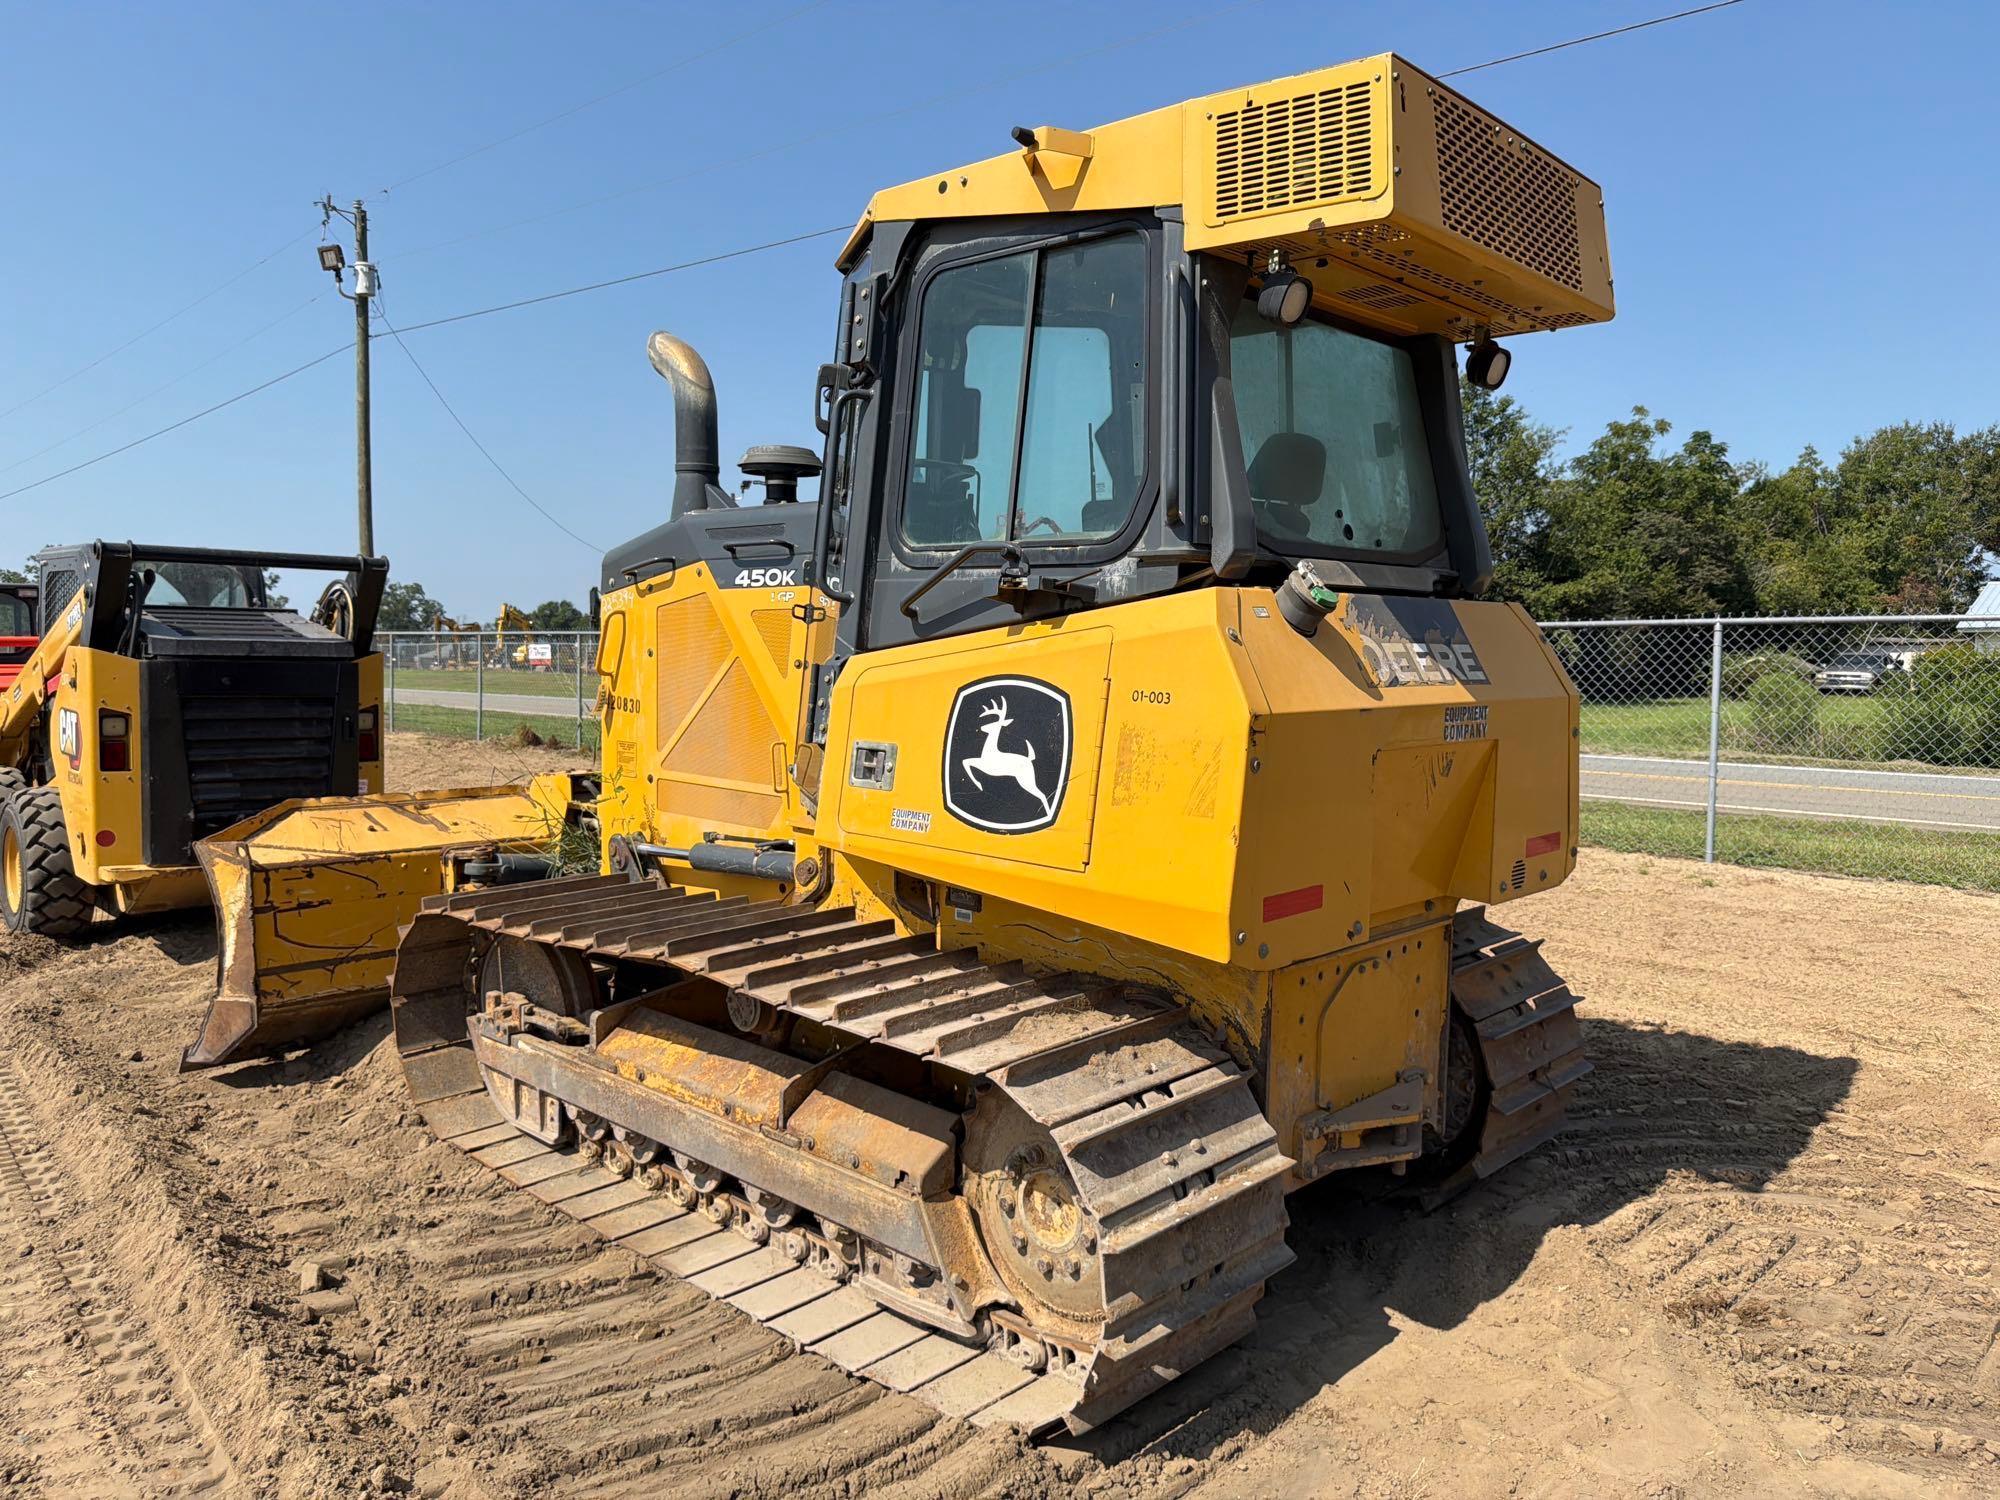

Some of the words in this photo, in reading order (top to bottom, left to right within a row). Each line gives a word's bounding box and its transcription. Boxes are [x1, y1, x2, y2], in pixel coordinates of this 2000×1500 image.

[734, 568, 796, 587] 450K
[1358, 634, 1488, 682] DEERE
[1131, 690, 1171, 704] 01-003
[1444, 705, 1488, 722] EQUIPMENT
[59, 708, 78, 755] CAT
[1443, 722, 1487, 740] COMPANY
[892, 808, 930, 822] EQUIPMENT
[891, 818, 929, 832] COMPANY
